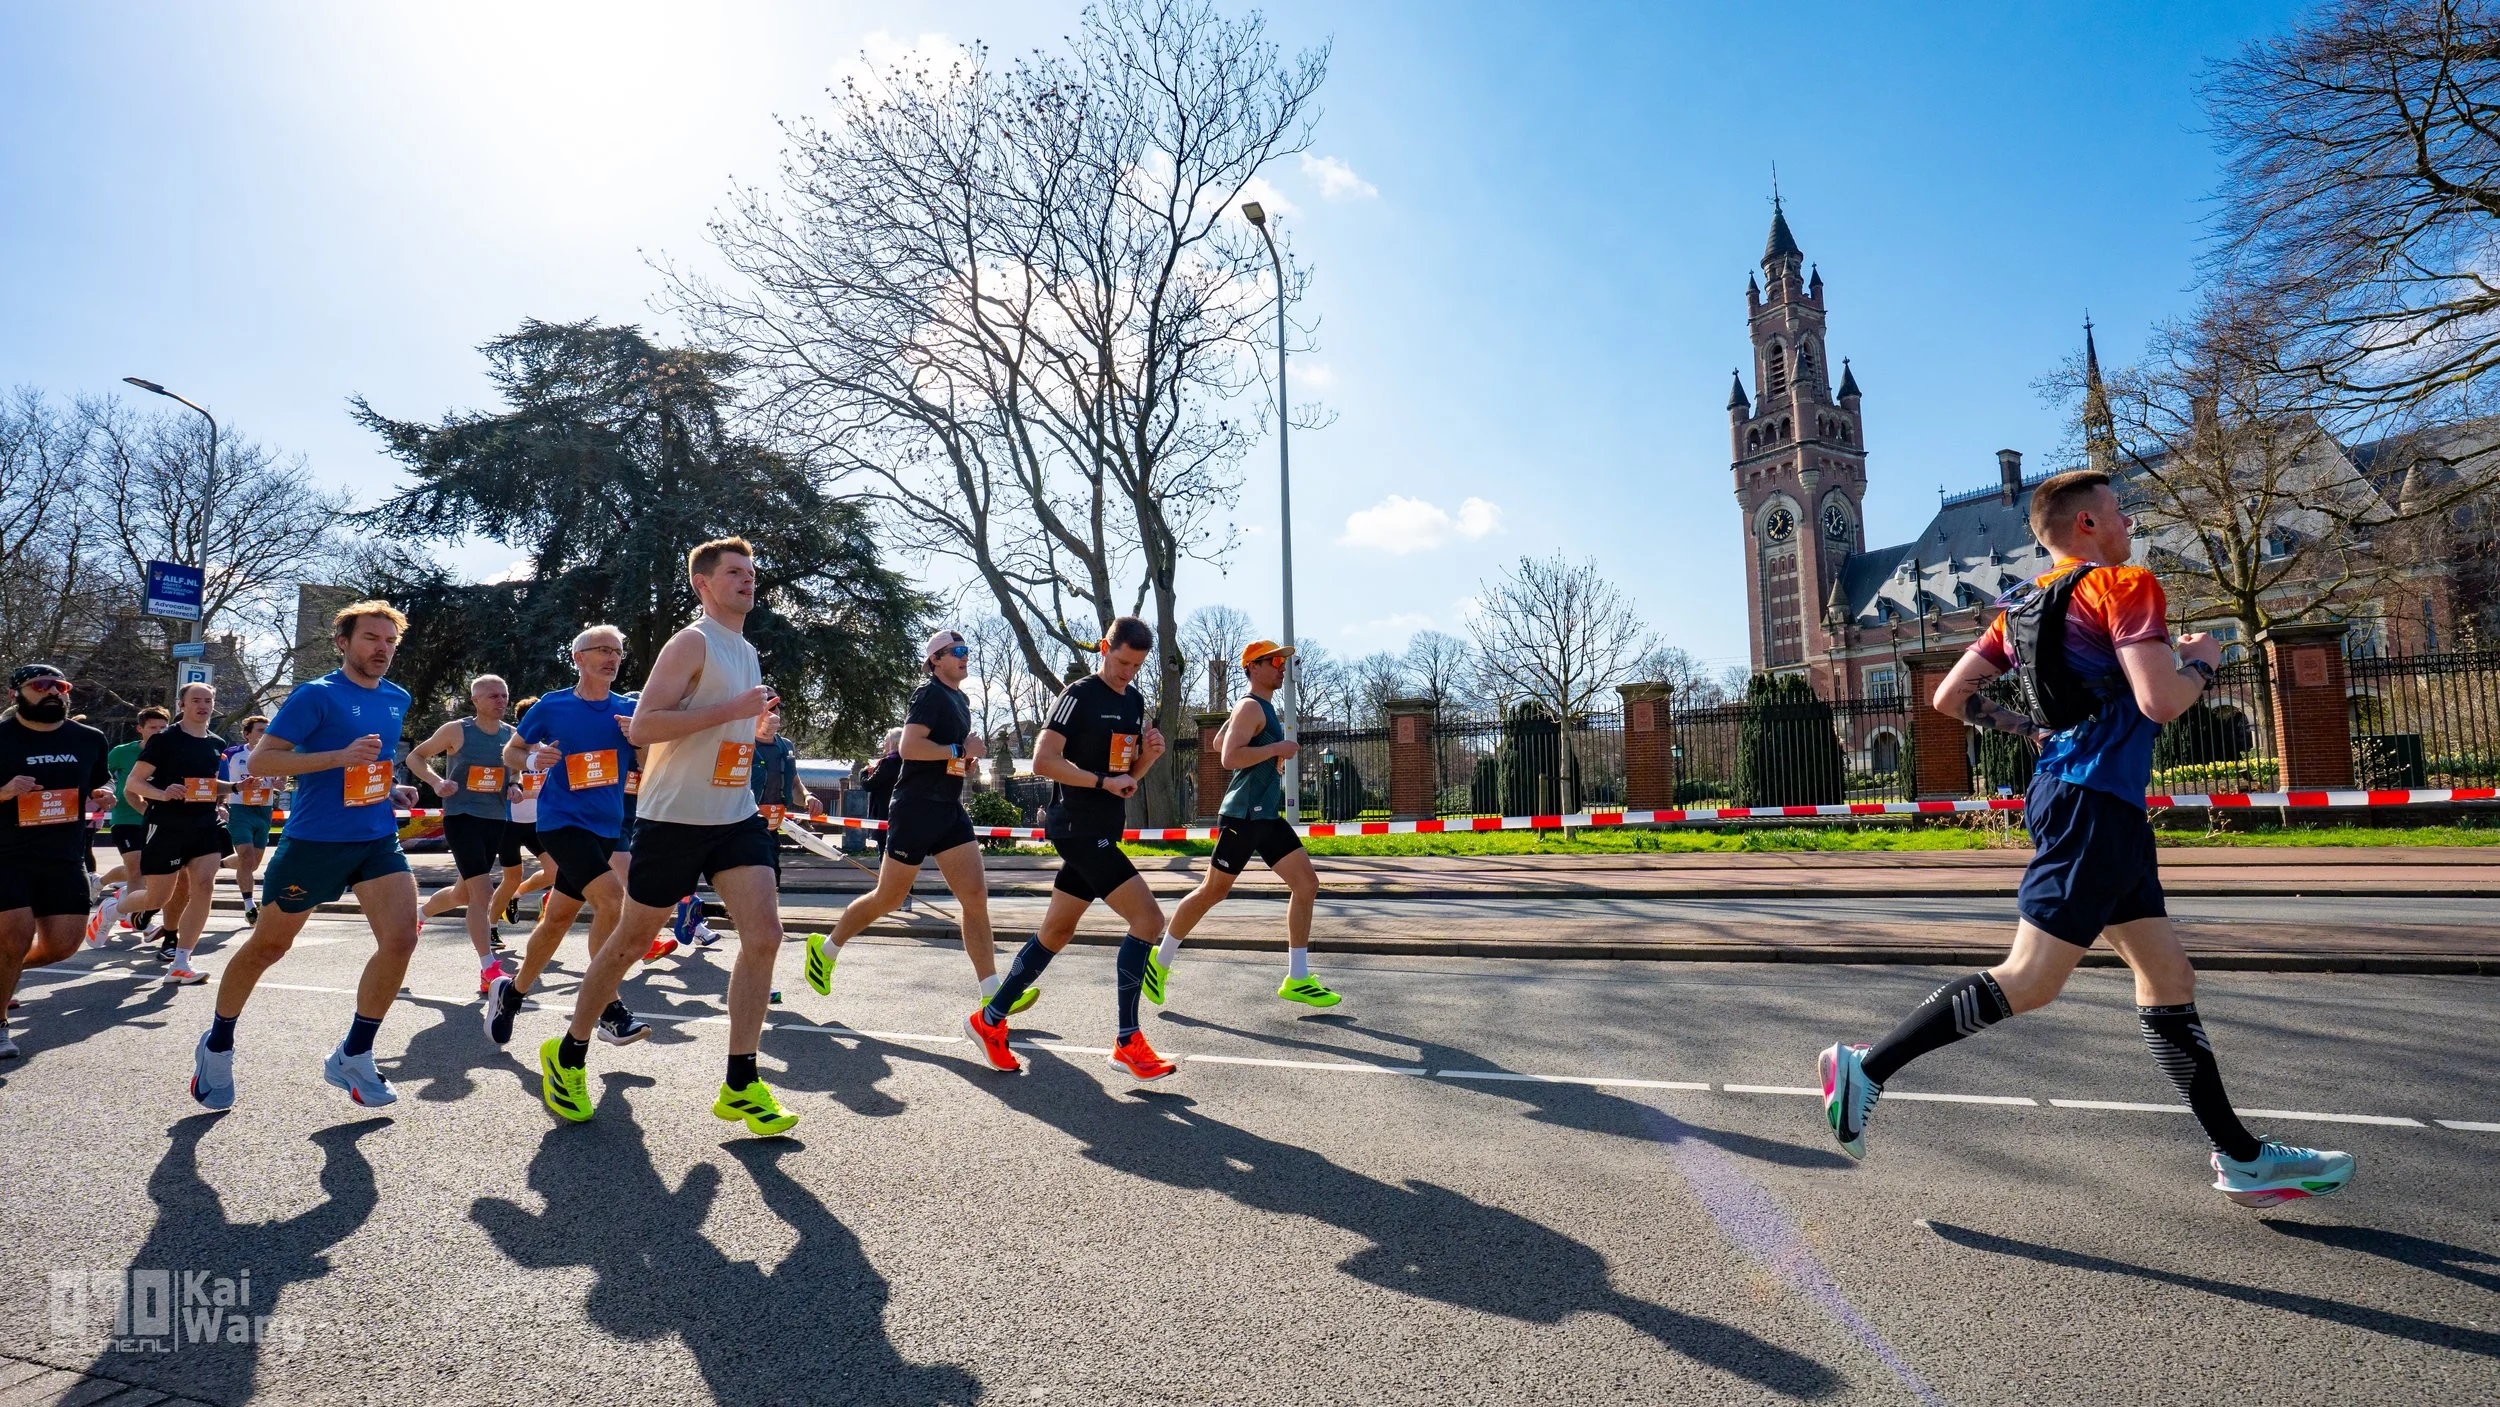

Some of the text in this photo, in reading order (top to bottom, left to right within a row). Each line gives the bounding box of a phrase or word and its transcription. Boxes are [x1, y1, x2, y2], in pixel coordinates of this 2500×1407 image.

[163, 574, 199, 587] AILF.NL
[154, 601, 193, 611] Advocaten
[148, 607, 197, 618] migratierecht
[2022, 675, 2039, 710] KIPRUN
[26, 754, 78, 765] STRAVA
[42, 800, 62, 808] 16436
[39, 807, 66, 817] SAIMA
